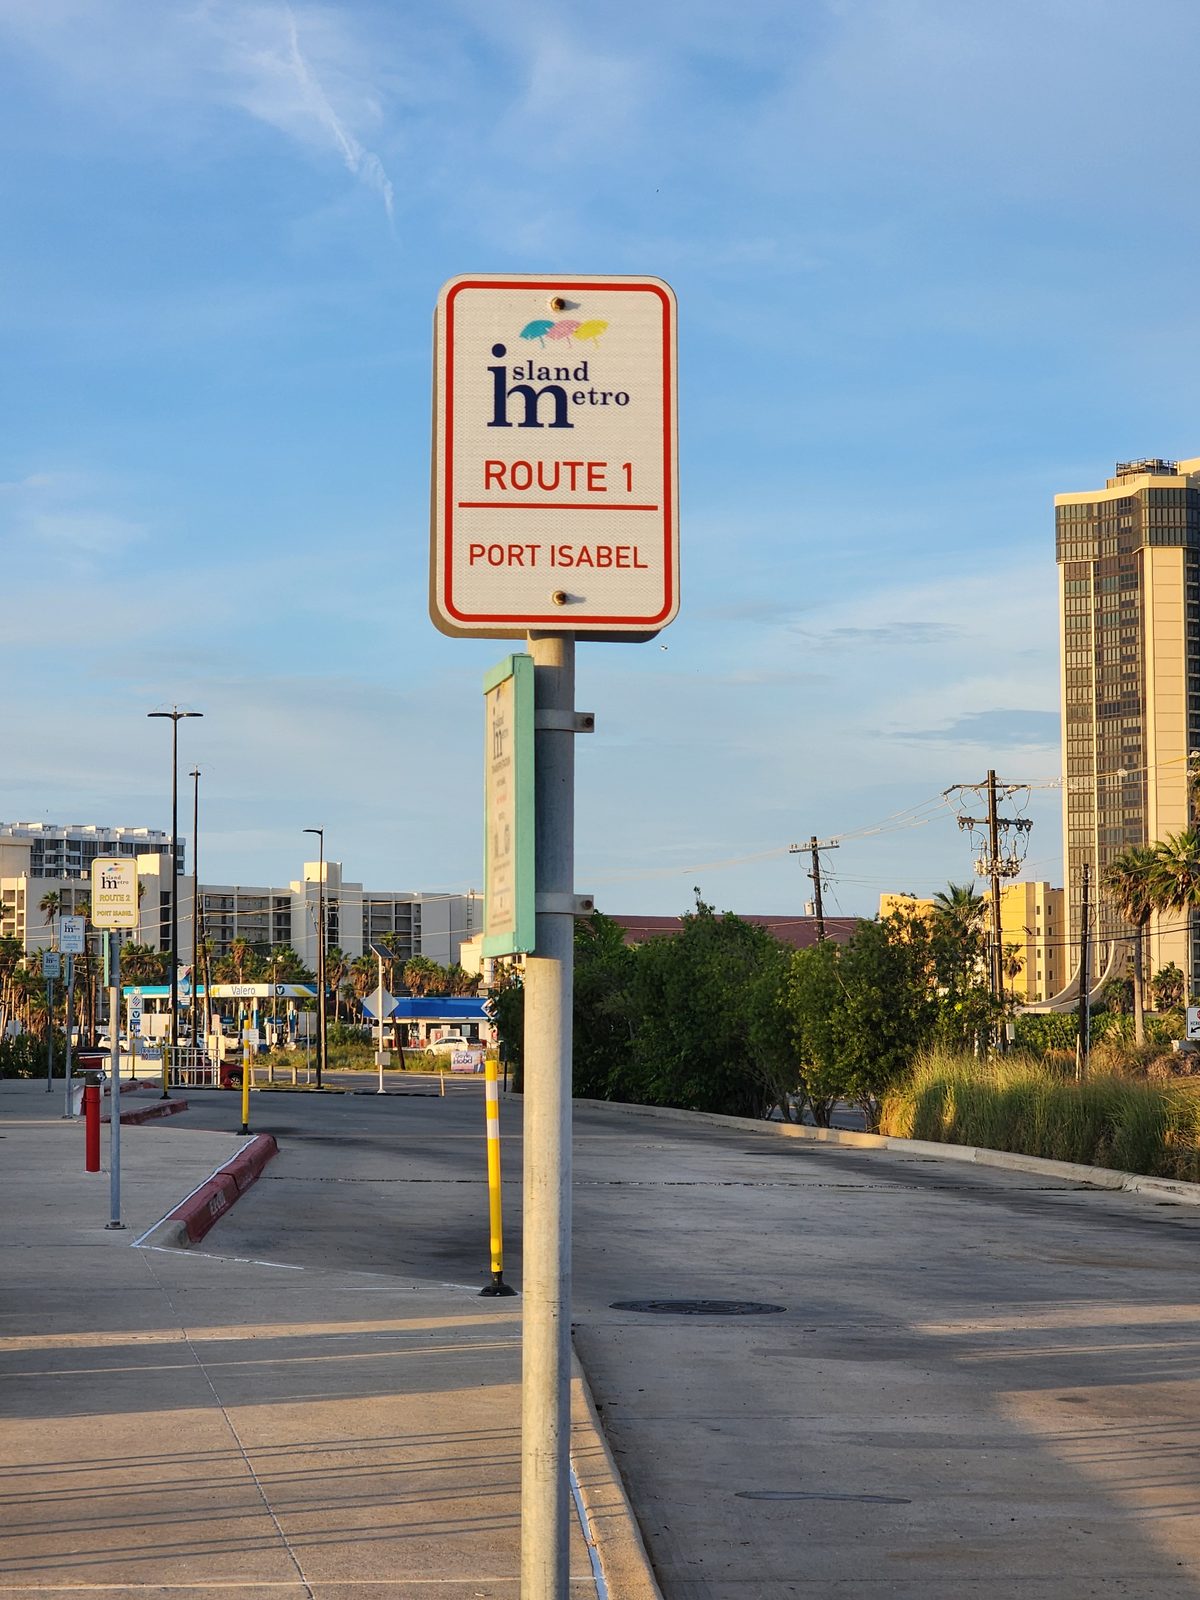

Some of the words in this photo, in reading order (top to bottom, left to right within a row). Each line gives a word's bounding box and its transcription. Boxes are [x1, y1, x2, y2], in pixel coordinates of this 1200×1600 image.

[484, 460, 608, 492] ROUTE
[622, 462, 632, 492] 1
[469, 543, 541, 568] PORT
[549, 545, 648, 569] ISABEL
[100, 894, 124, 902] ROUTE
[231, 986, 256, 996] Valero
